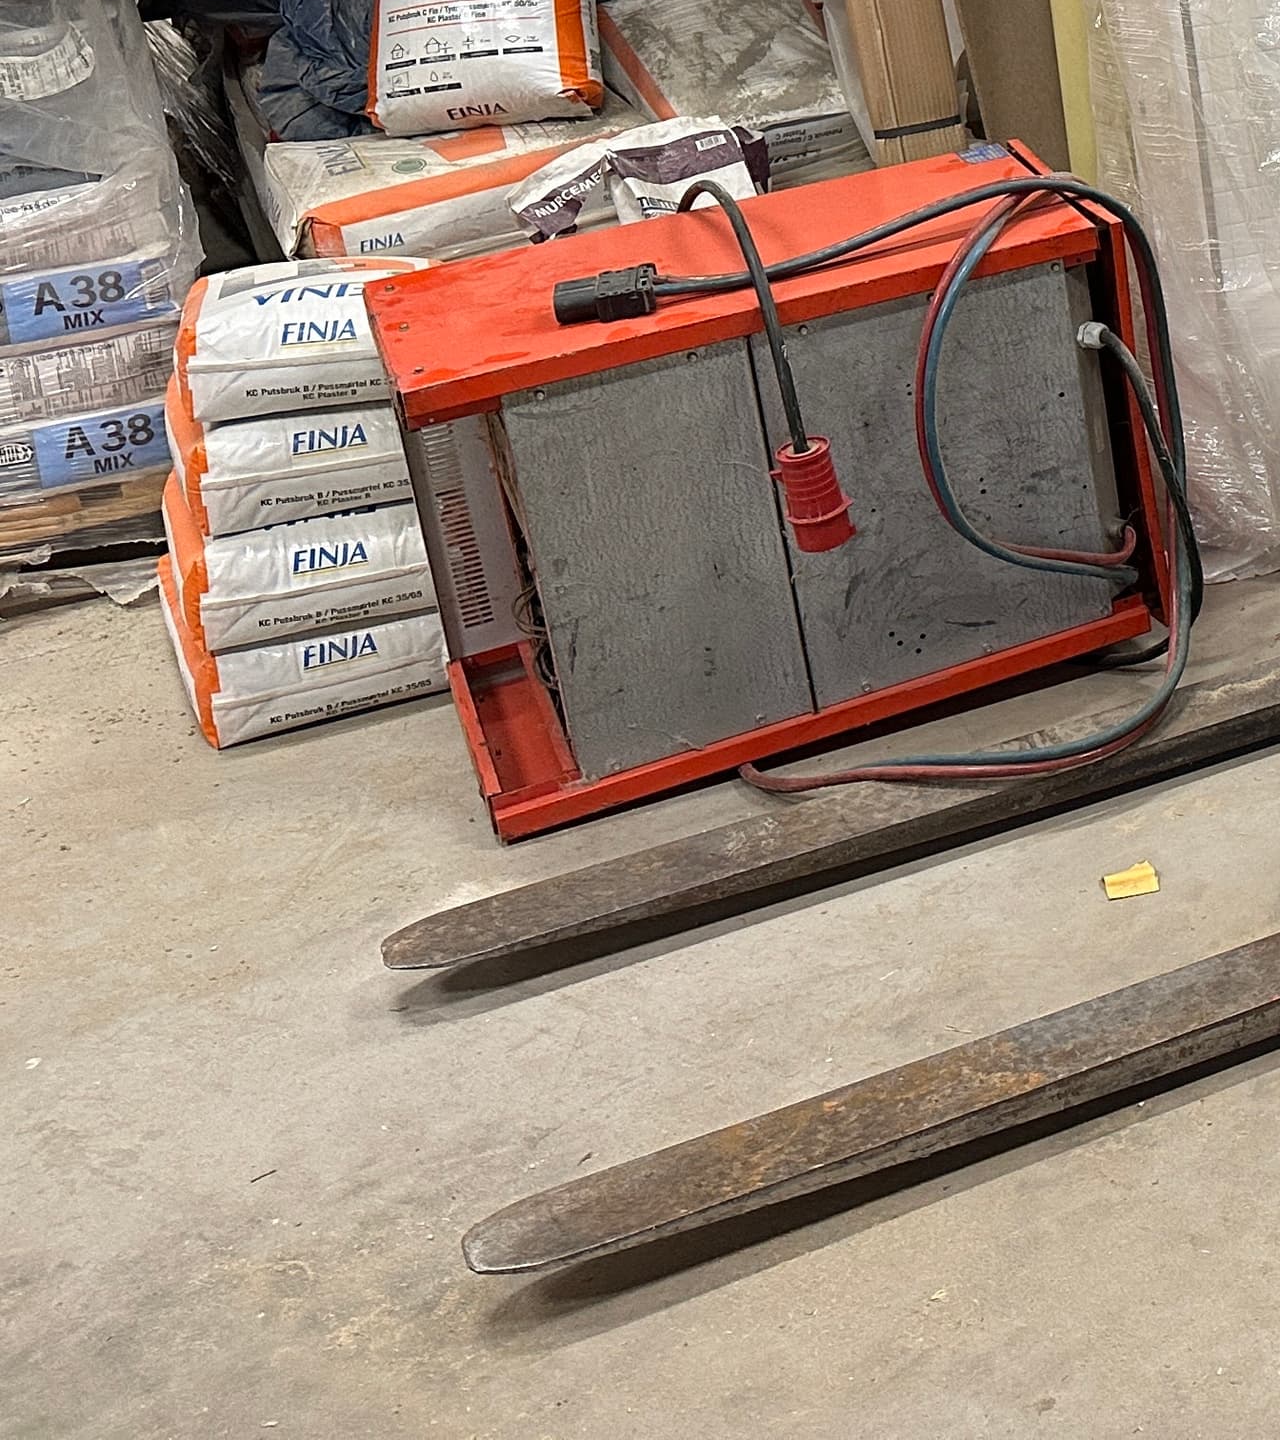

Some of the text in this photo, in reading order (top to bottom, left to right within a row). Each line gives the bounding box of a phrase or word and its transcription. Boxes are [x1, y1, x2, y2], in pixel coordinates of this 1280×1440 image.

[447, 102, 509, 121] FINJA
[360, 232, 405, 253] FINJA
[64, 309, 105, 330] MIX
[281, 318, 357, 346] FINJA
[292, 422, 368, 455] FINJA
[94, 452, 135, 474] MIX
[292, 540, 369, 574] FINJA
[303, 632, 378, 670] FINJA
